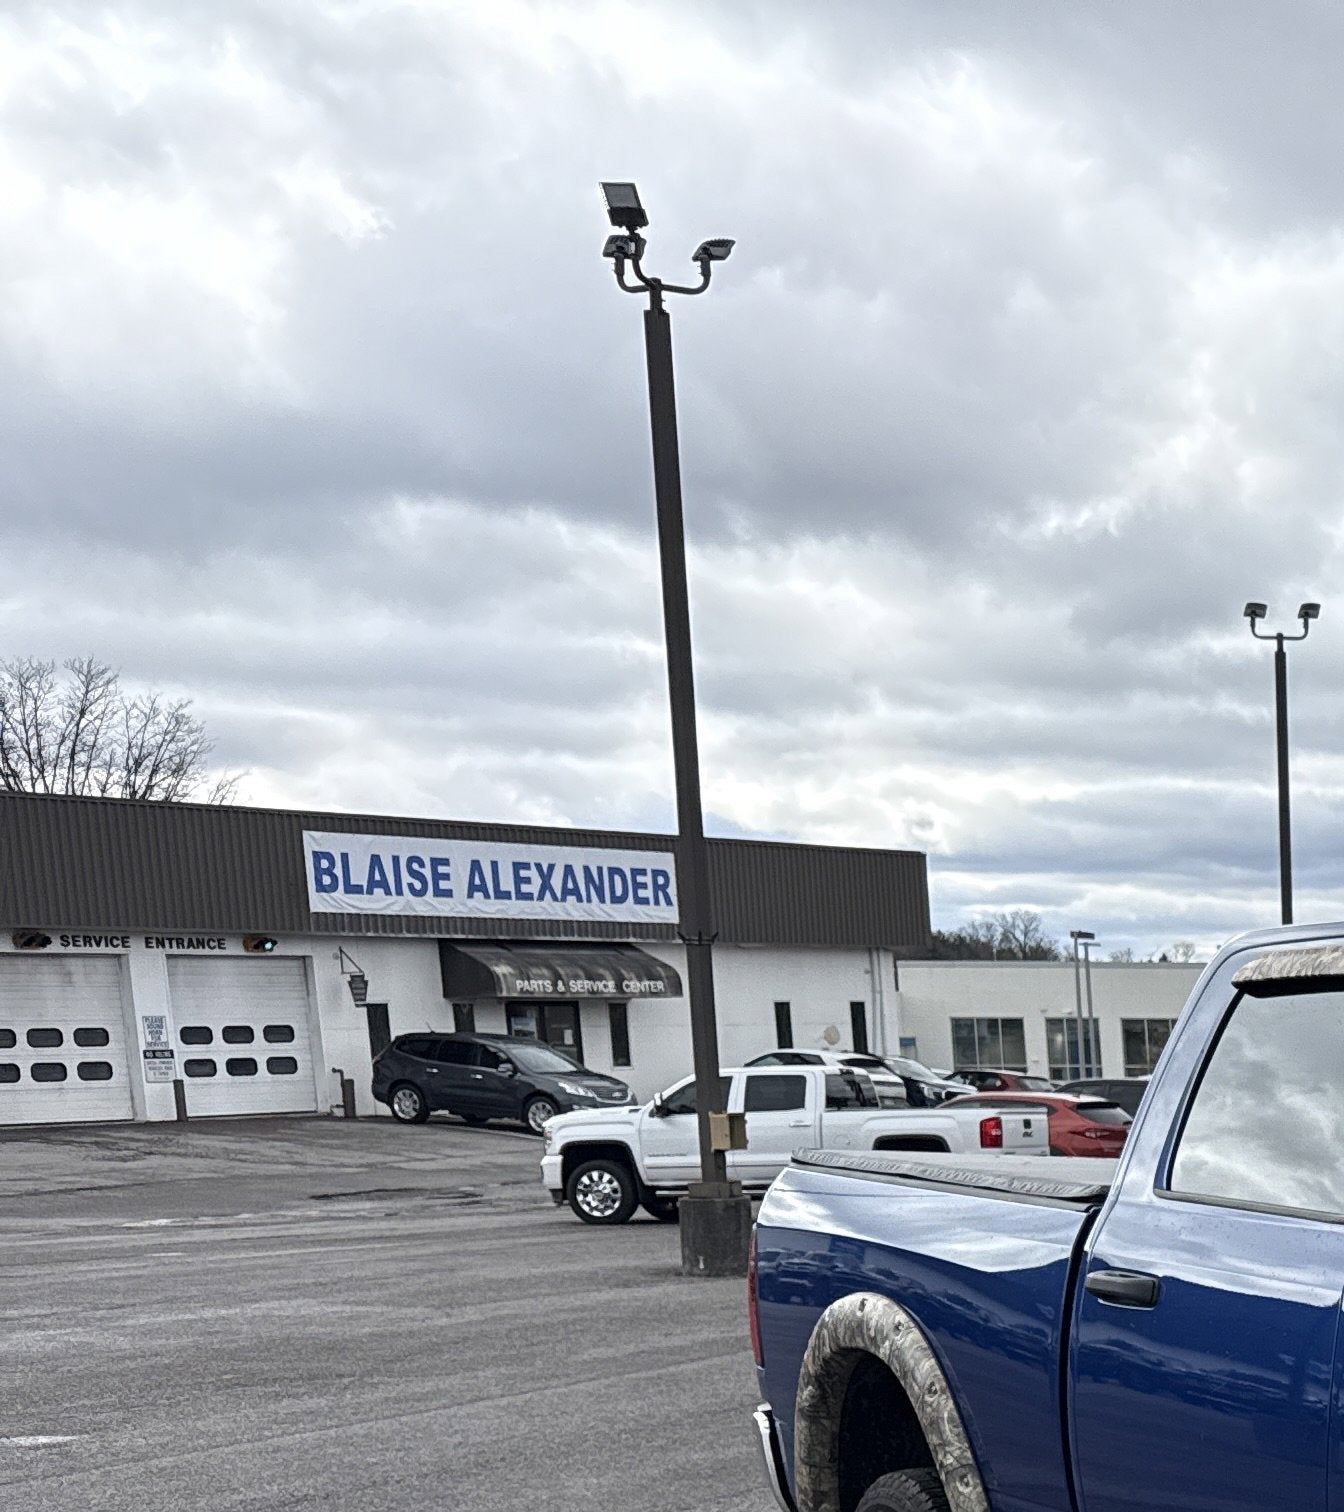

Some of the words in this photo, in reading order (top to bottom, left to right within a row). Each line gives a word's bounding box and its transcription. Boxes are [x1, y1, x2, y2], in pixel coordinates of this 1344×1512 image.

[312, 850, 453, 899] BLAISE
[466, 859, 674, 906] ALEXANDER
[59, 934, 131, 949] SERVICE
[144, 936, 227, 950] ENTRANCE
[515, 980, 553, 992] PARTS
[557, 980, 565, 992] &
[569, 980, 617, 992] SERVICE
[622, 980, 665, 992] CENTER
